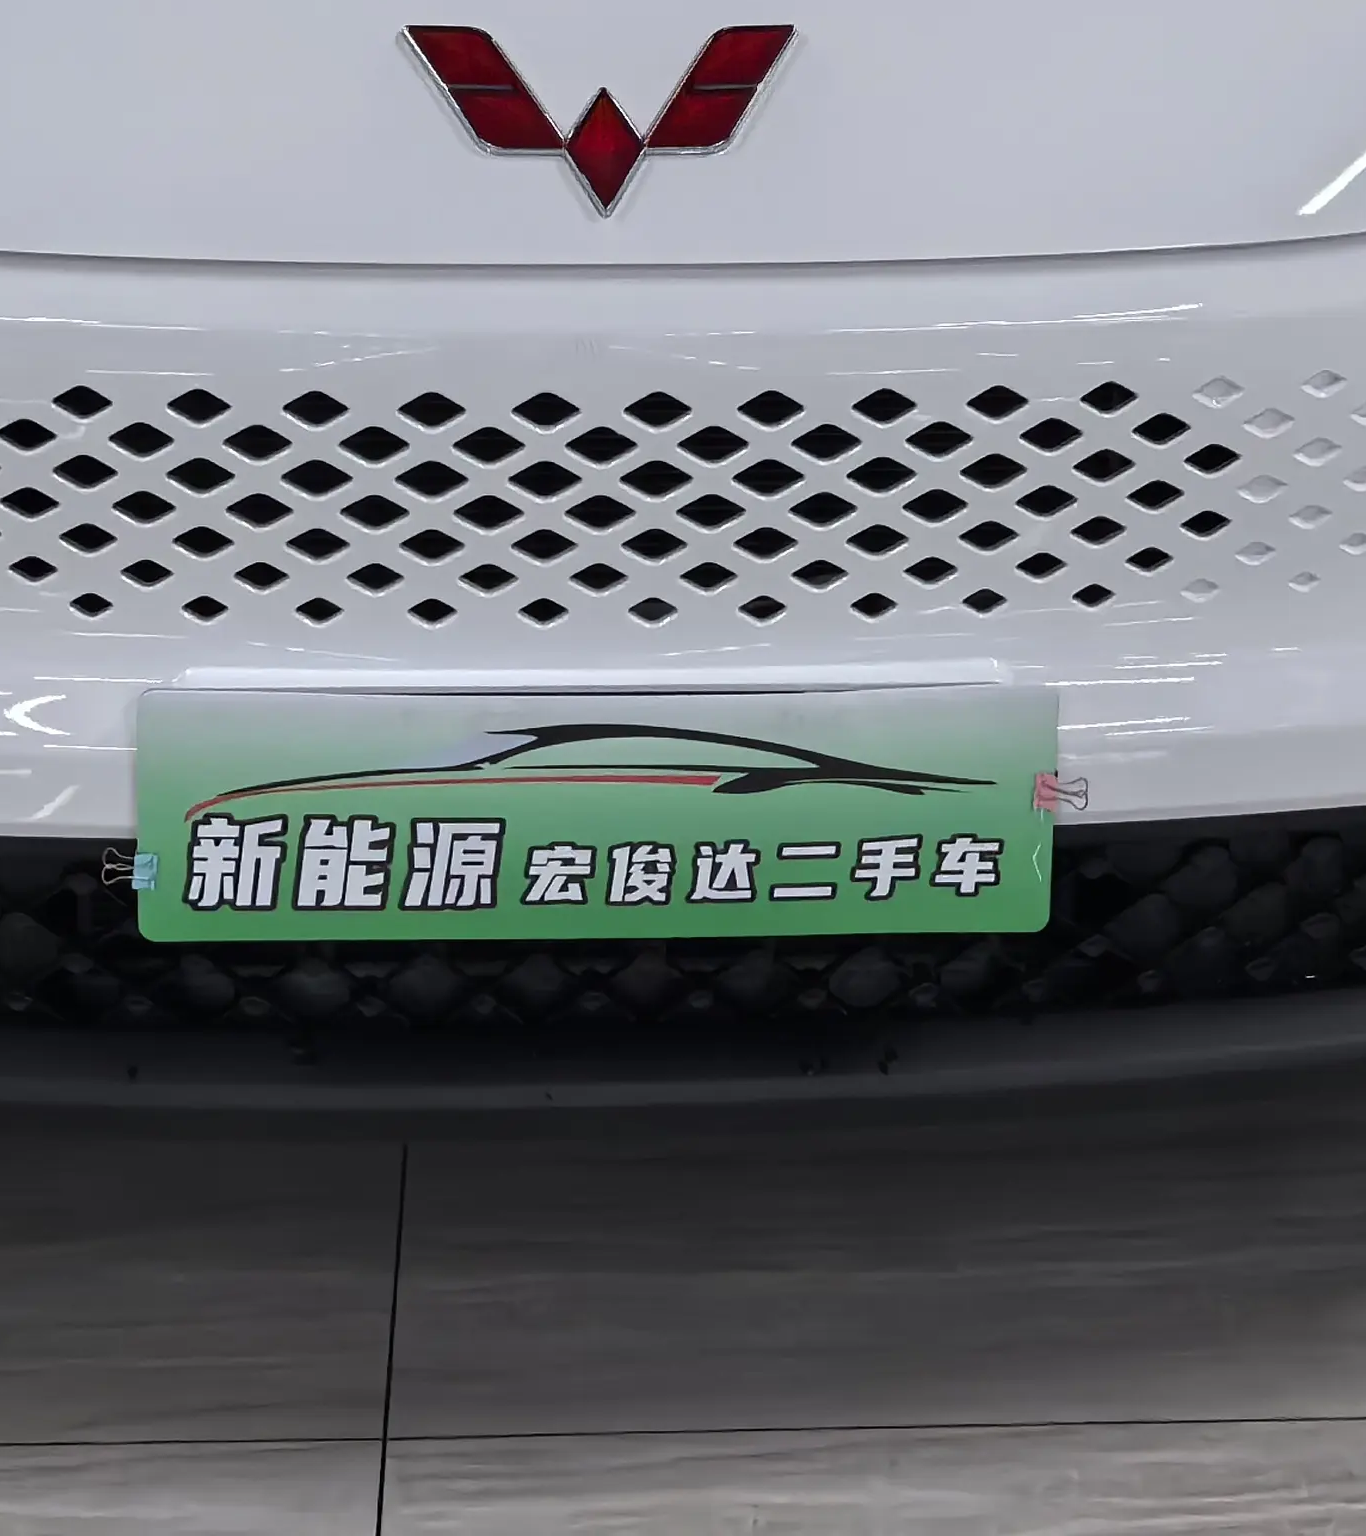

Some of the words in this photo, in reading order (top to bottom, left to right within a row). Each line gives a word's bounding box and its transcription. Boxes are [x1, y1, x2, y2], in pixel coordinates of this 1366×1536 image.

[188, 814, 506, 911] 新能源
[521, 834, 1006, 905] 宏俊达二手车
